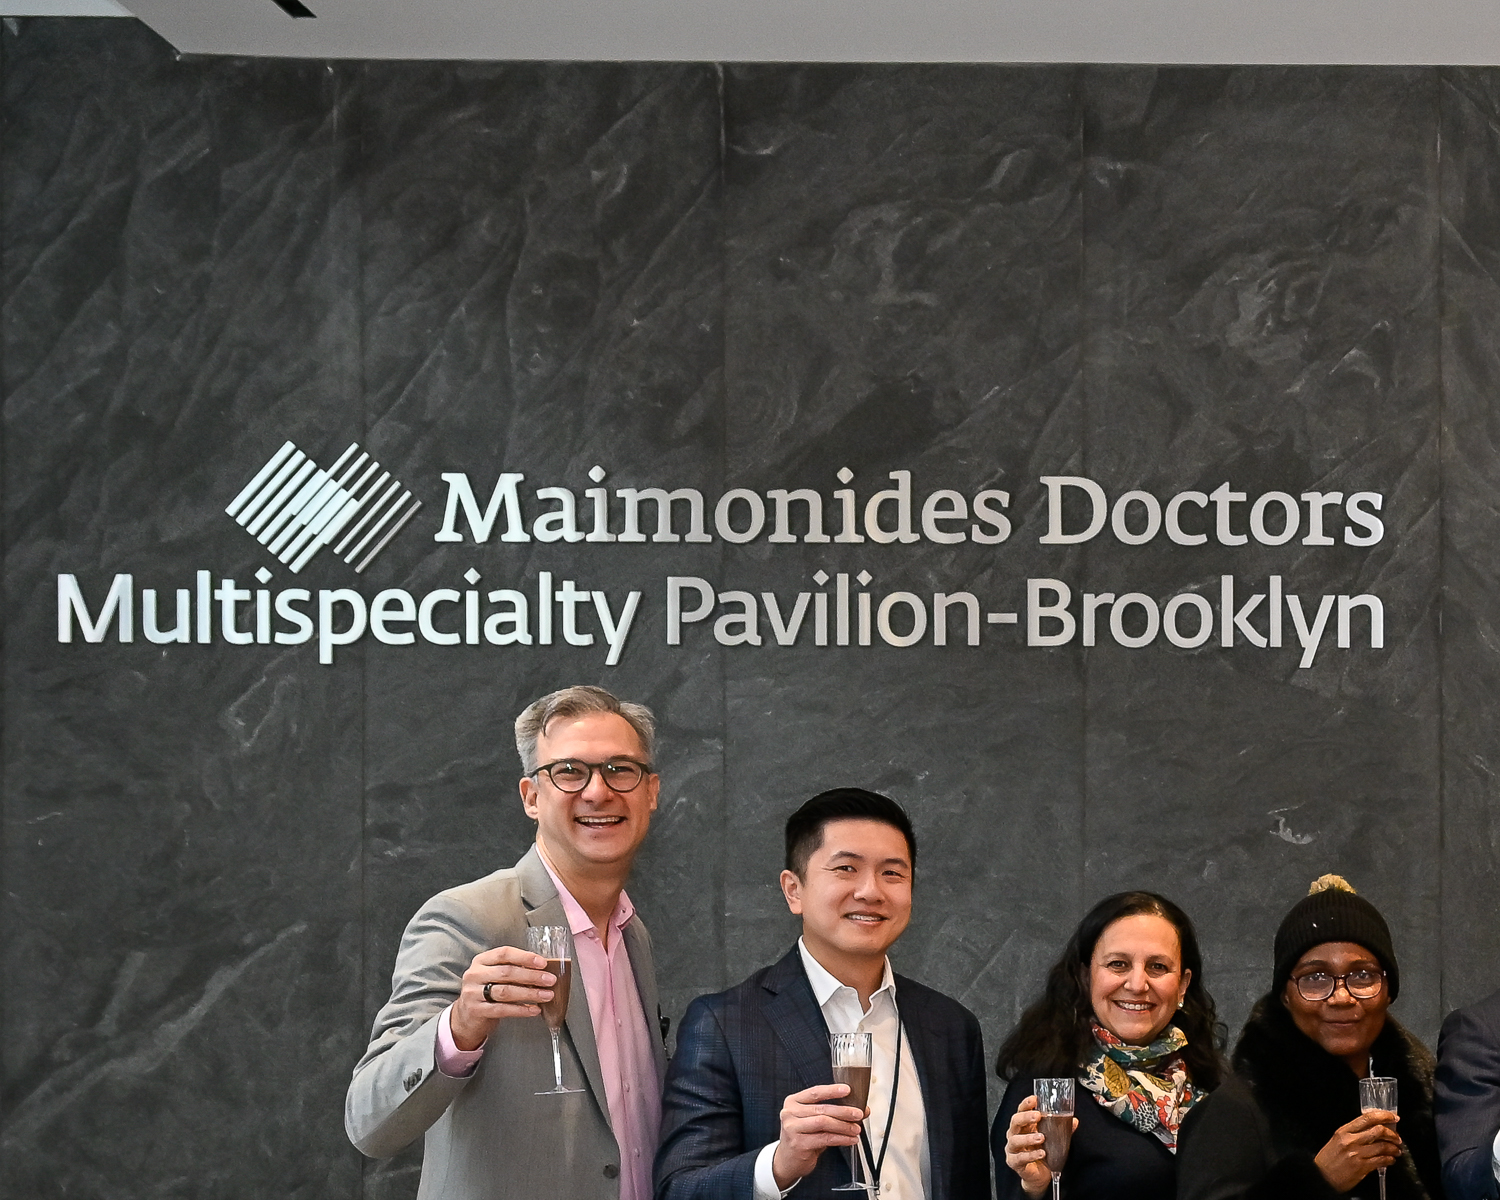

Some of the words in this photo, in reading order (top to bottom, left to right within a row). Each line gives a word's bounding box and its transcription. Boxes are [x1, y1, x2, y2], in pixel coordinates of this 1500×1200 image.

[434, 465, 1011, 547] Maimonides
[1039, 473, 1386, 548] Doctors
[56, 568, 641, 667] Multispecialty
[665, 571, 1386, 669] Pavilion-Brooklyn
